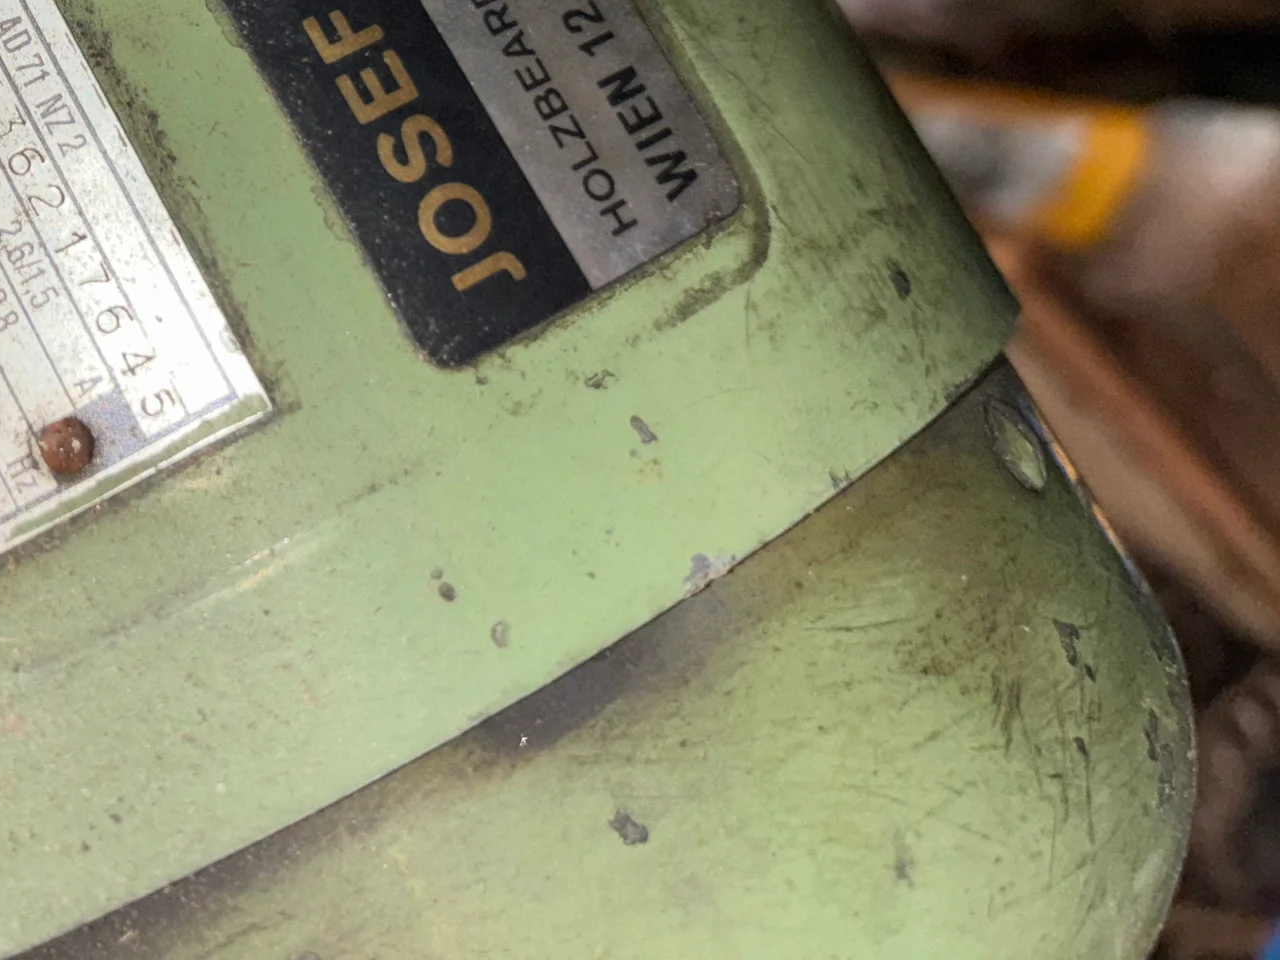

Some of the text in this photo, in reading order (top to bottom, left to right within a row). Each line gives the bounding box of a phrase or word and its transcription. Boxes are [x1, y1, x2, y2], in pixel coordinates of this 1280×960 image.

[13, 51, 52, 89] 71
[33, 91, 78, 137] NZ
[597, 65, 700, 204] WIEN
[55, 132, 89, 159] 2
[301, 8, 527, 293] JOSEF
[71, 376, 99, 401] A
